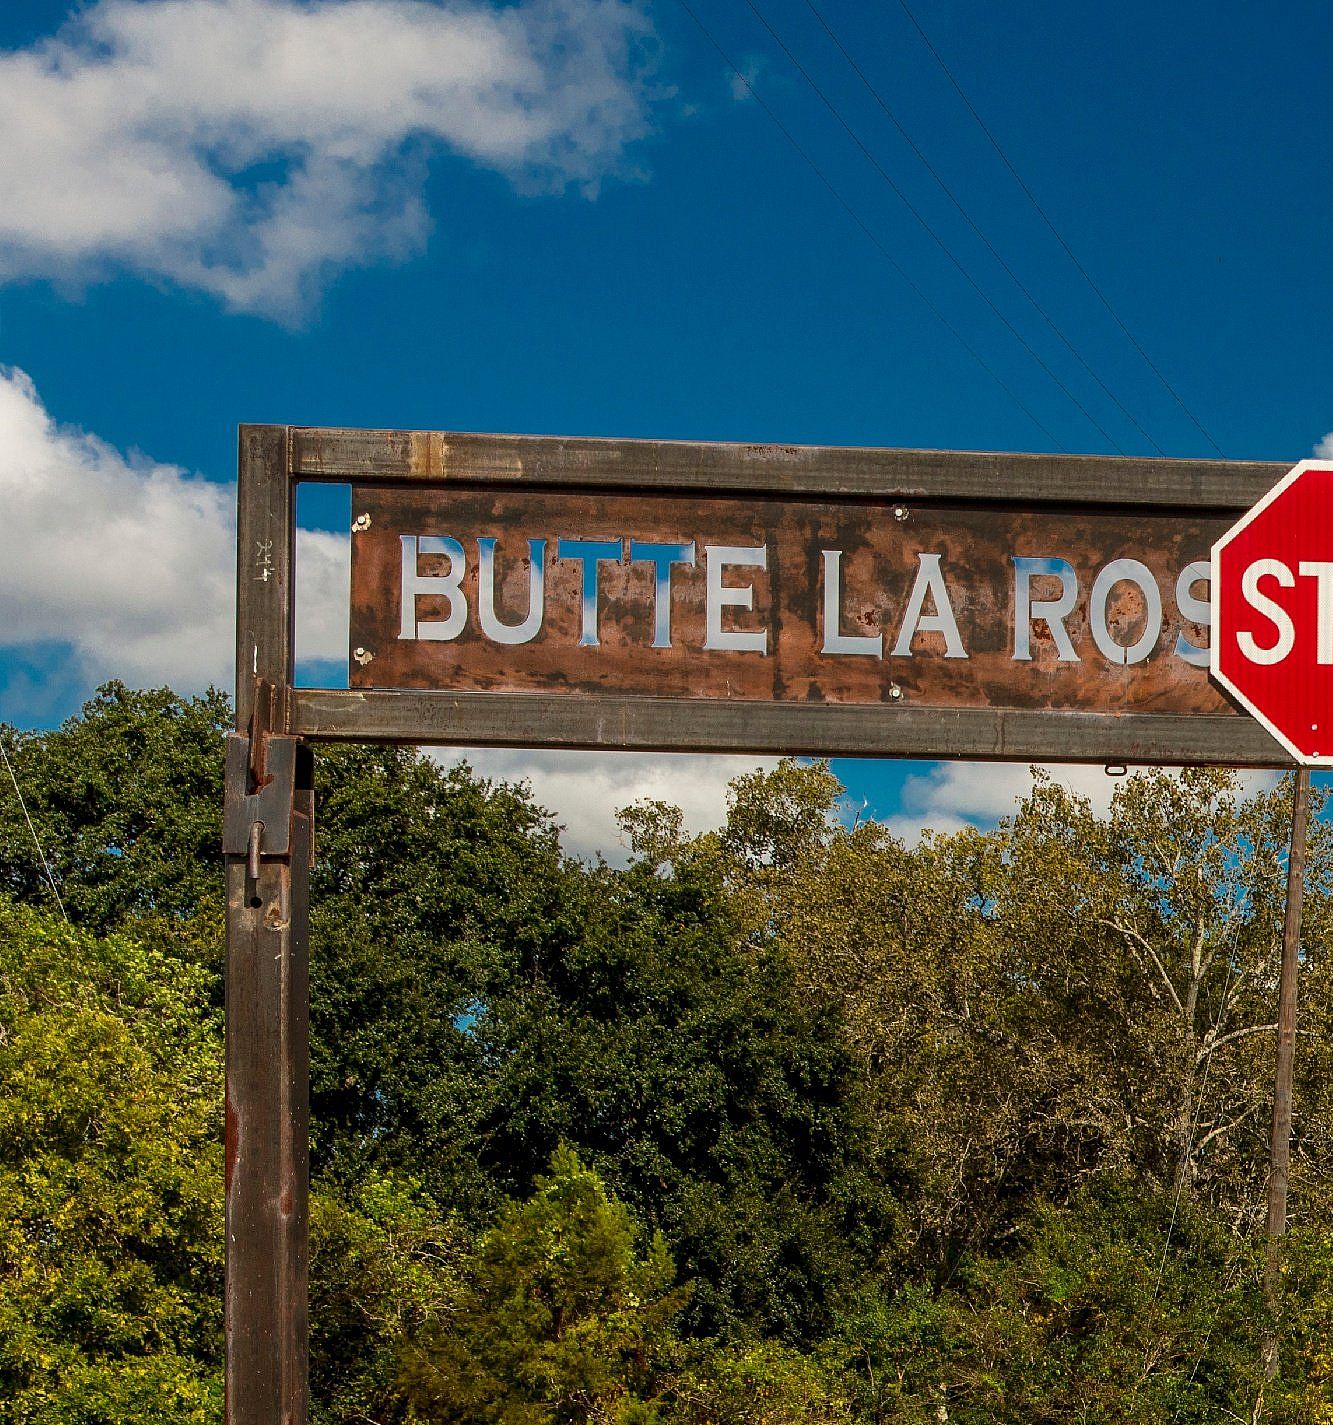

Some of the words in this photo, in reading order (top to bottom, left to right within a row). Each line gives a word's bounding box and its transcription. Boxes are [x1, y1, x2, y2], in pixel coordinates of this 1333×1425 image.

[397, 533, 769, 656] BUTTE
[820, 549, 969, 660] LA
[1011, 555, 1211, 668] ROS
